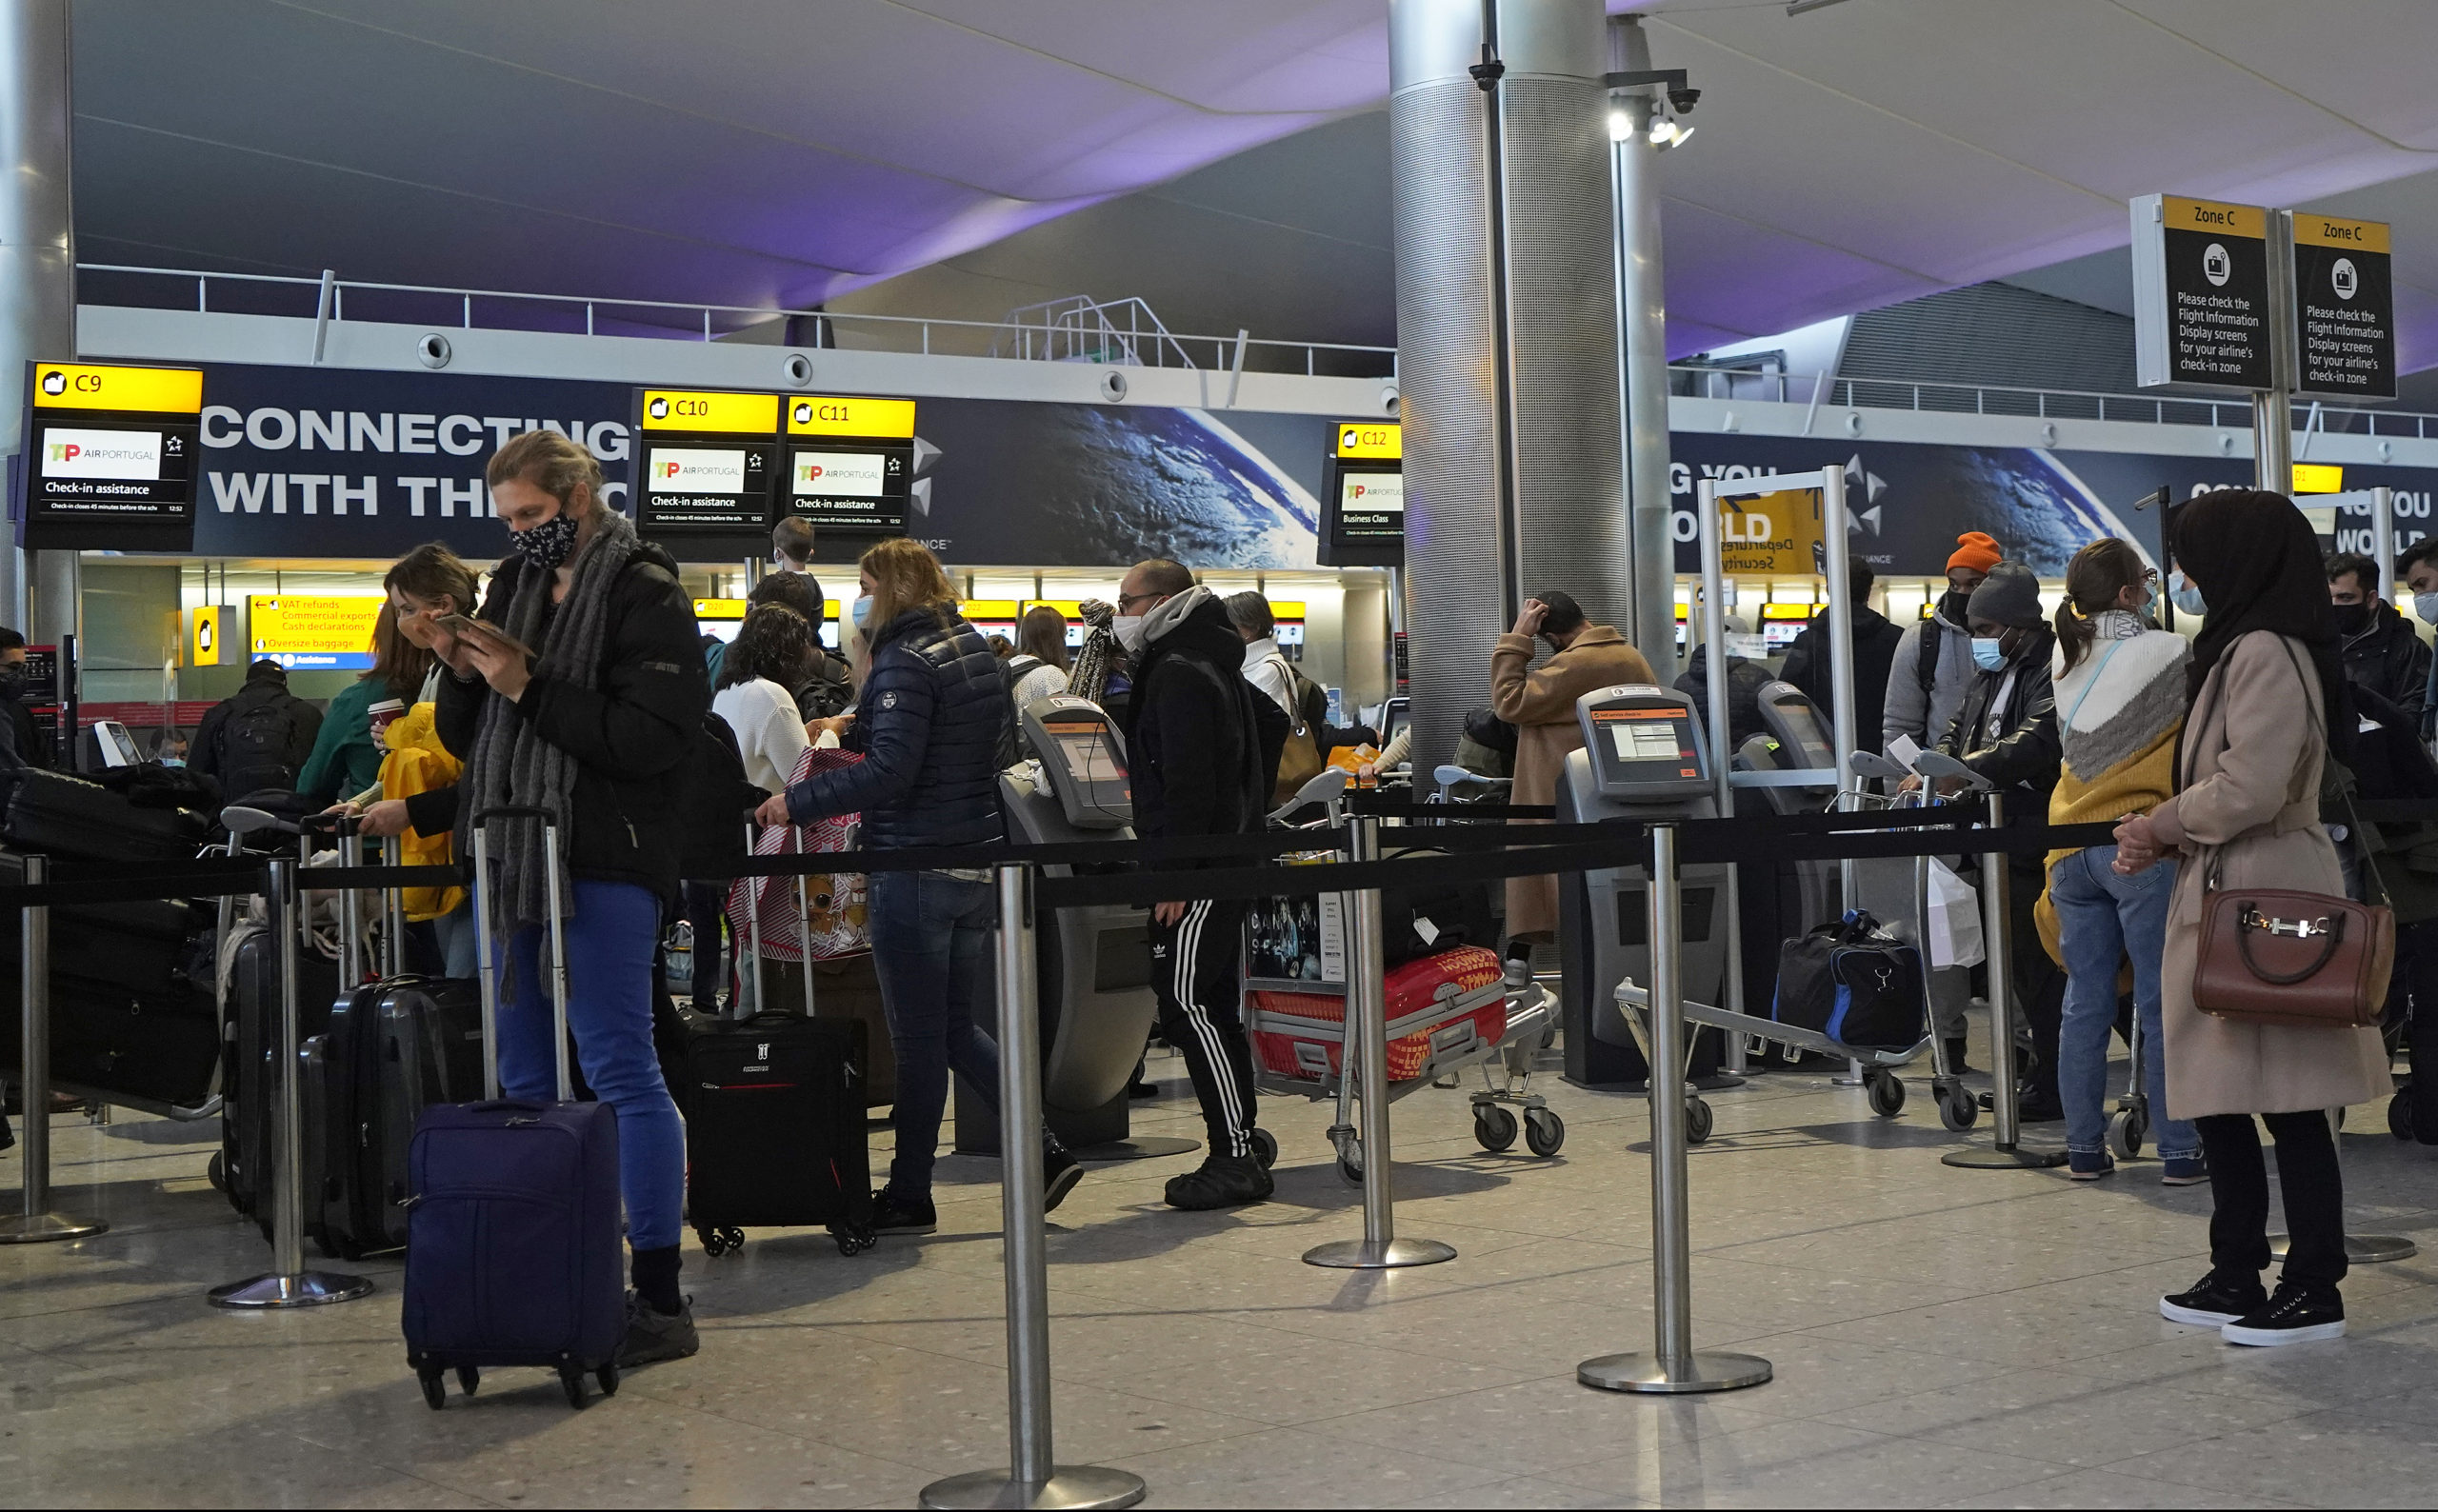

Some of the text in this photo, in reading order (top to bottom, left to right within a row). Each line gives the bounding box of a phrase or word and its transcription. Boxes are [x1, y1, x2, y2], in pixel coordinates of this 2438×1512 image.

[2194, 207, 2235, 226] Zone C
[2324, 223, 2362, 241] Zone C
[2178, 291, 2249, 310] Please check the
[2179, 308, 2259, 327] Flight Information
[2307, 306, 2375, 323] Please check the
[2179, 325, 2248, 342] Display screens
[2308, 321, 2384, 339] Flight Information
[2180, 341, 2194, 354] for
[2195, 345, 2217, 360] your
[2308, 337, 2373, 354] Display screens
[2180, 358, 2242, 374] check-in zone
[2308, 353, 2322, 366] for
[2324, 356, 2344, 370] your
[75, 374, 102, 392] C9
[2309, 369, 2368, 385] check-in zone
[675, 400, 709, 417] C10
[819, 406, 849, 422] C11
[1362, 431, 1387, 445] C12
[45, 482, 150, 495] Check-in assistance
[208, 471, 497, 518] WITH TH
[651, 496, 736, 507] Check-in assistance
[795, 498, 875, 509] Check-in assistance
[2390, 490, 2430, 518] OU
[1343, 514, 1389, 523] Business Class
[1672, 510, 1771, 543] OLD
[2337, 528, 2427, 556] WOL
[281, 600, 340, 609] VAT refunds
[282, 611, 376, 622] Commercial exports
[282, 622, 366, 631] Cash declarations
[269, 639, 354, 649] Oversize baggage
